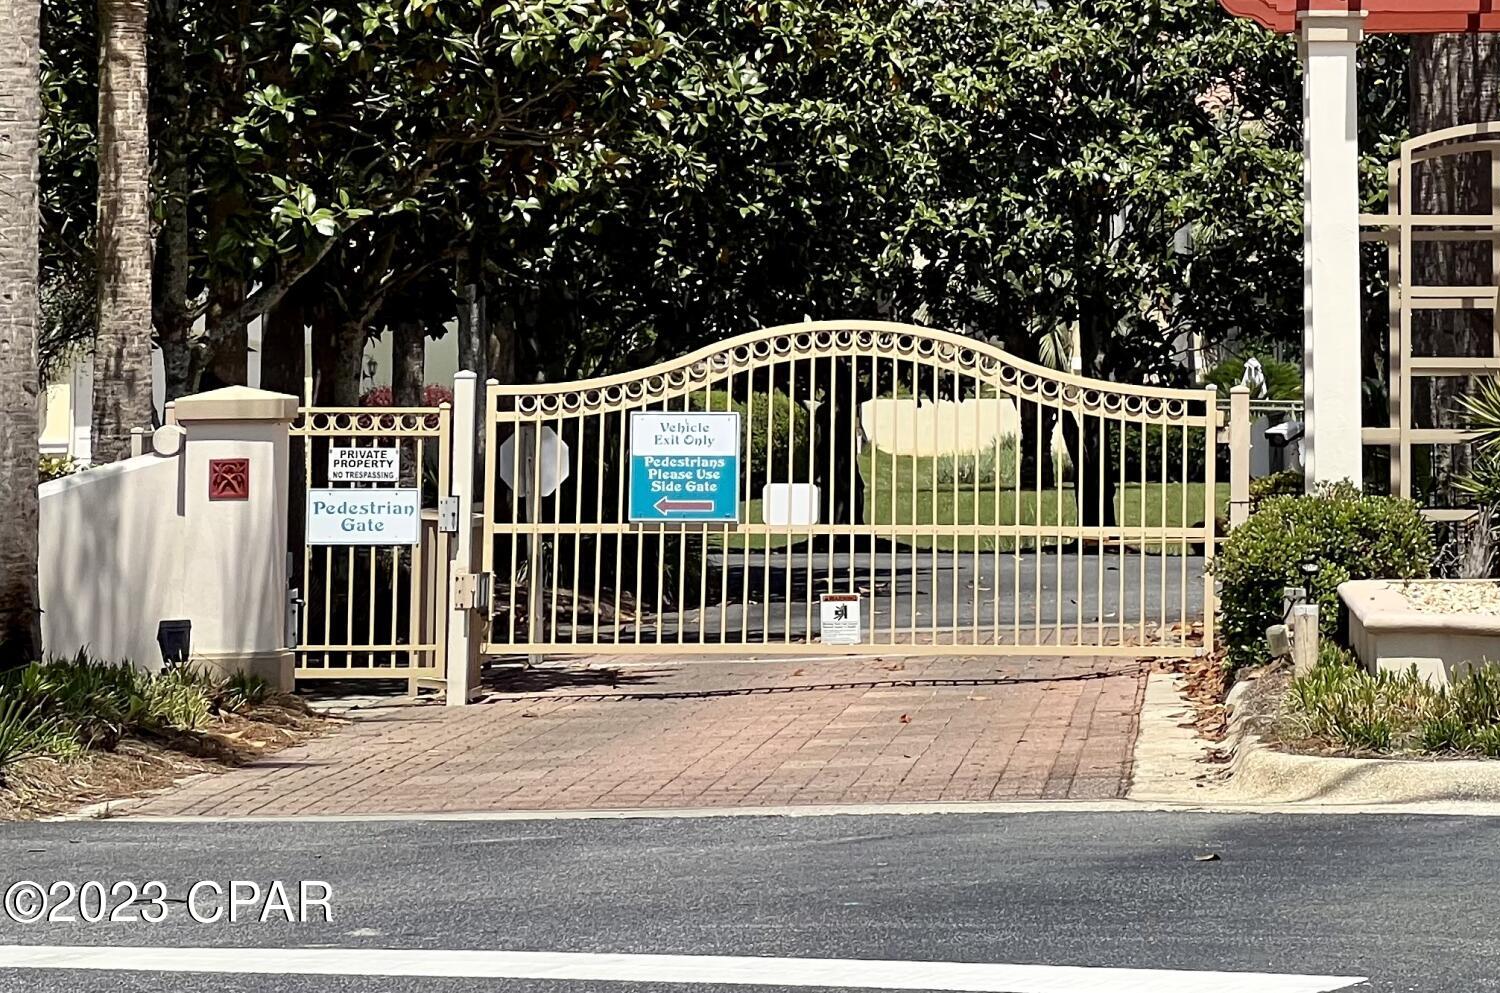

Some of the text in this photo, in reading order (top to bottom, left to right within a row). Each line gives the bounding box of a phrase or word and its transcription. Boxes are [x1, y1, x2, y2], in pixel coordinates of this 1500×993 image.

[660, 422, 710, 434] Vehicle
[654, 434, 716, 447] Exit Only
[340, 450, 388, 459] PRIVATE
[333, 459, 394, 468] PROPERTY
[644, 456, 725, 469] Pedestrians
[332, 471, 394, 479] NO TRESPASSING
[648, 468, 721, 480] Please Use
[651, 481, 718, 492] Side Gate
[313, 501, 415, 516] Pedestrian
[340, 517, 385, 532] Gate
